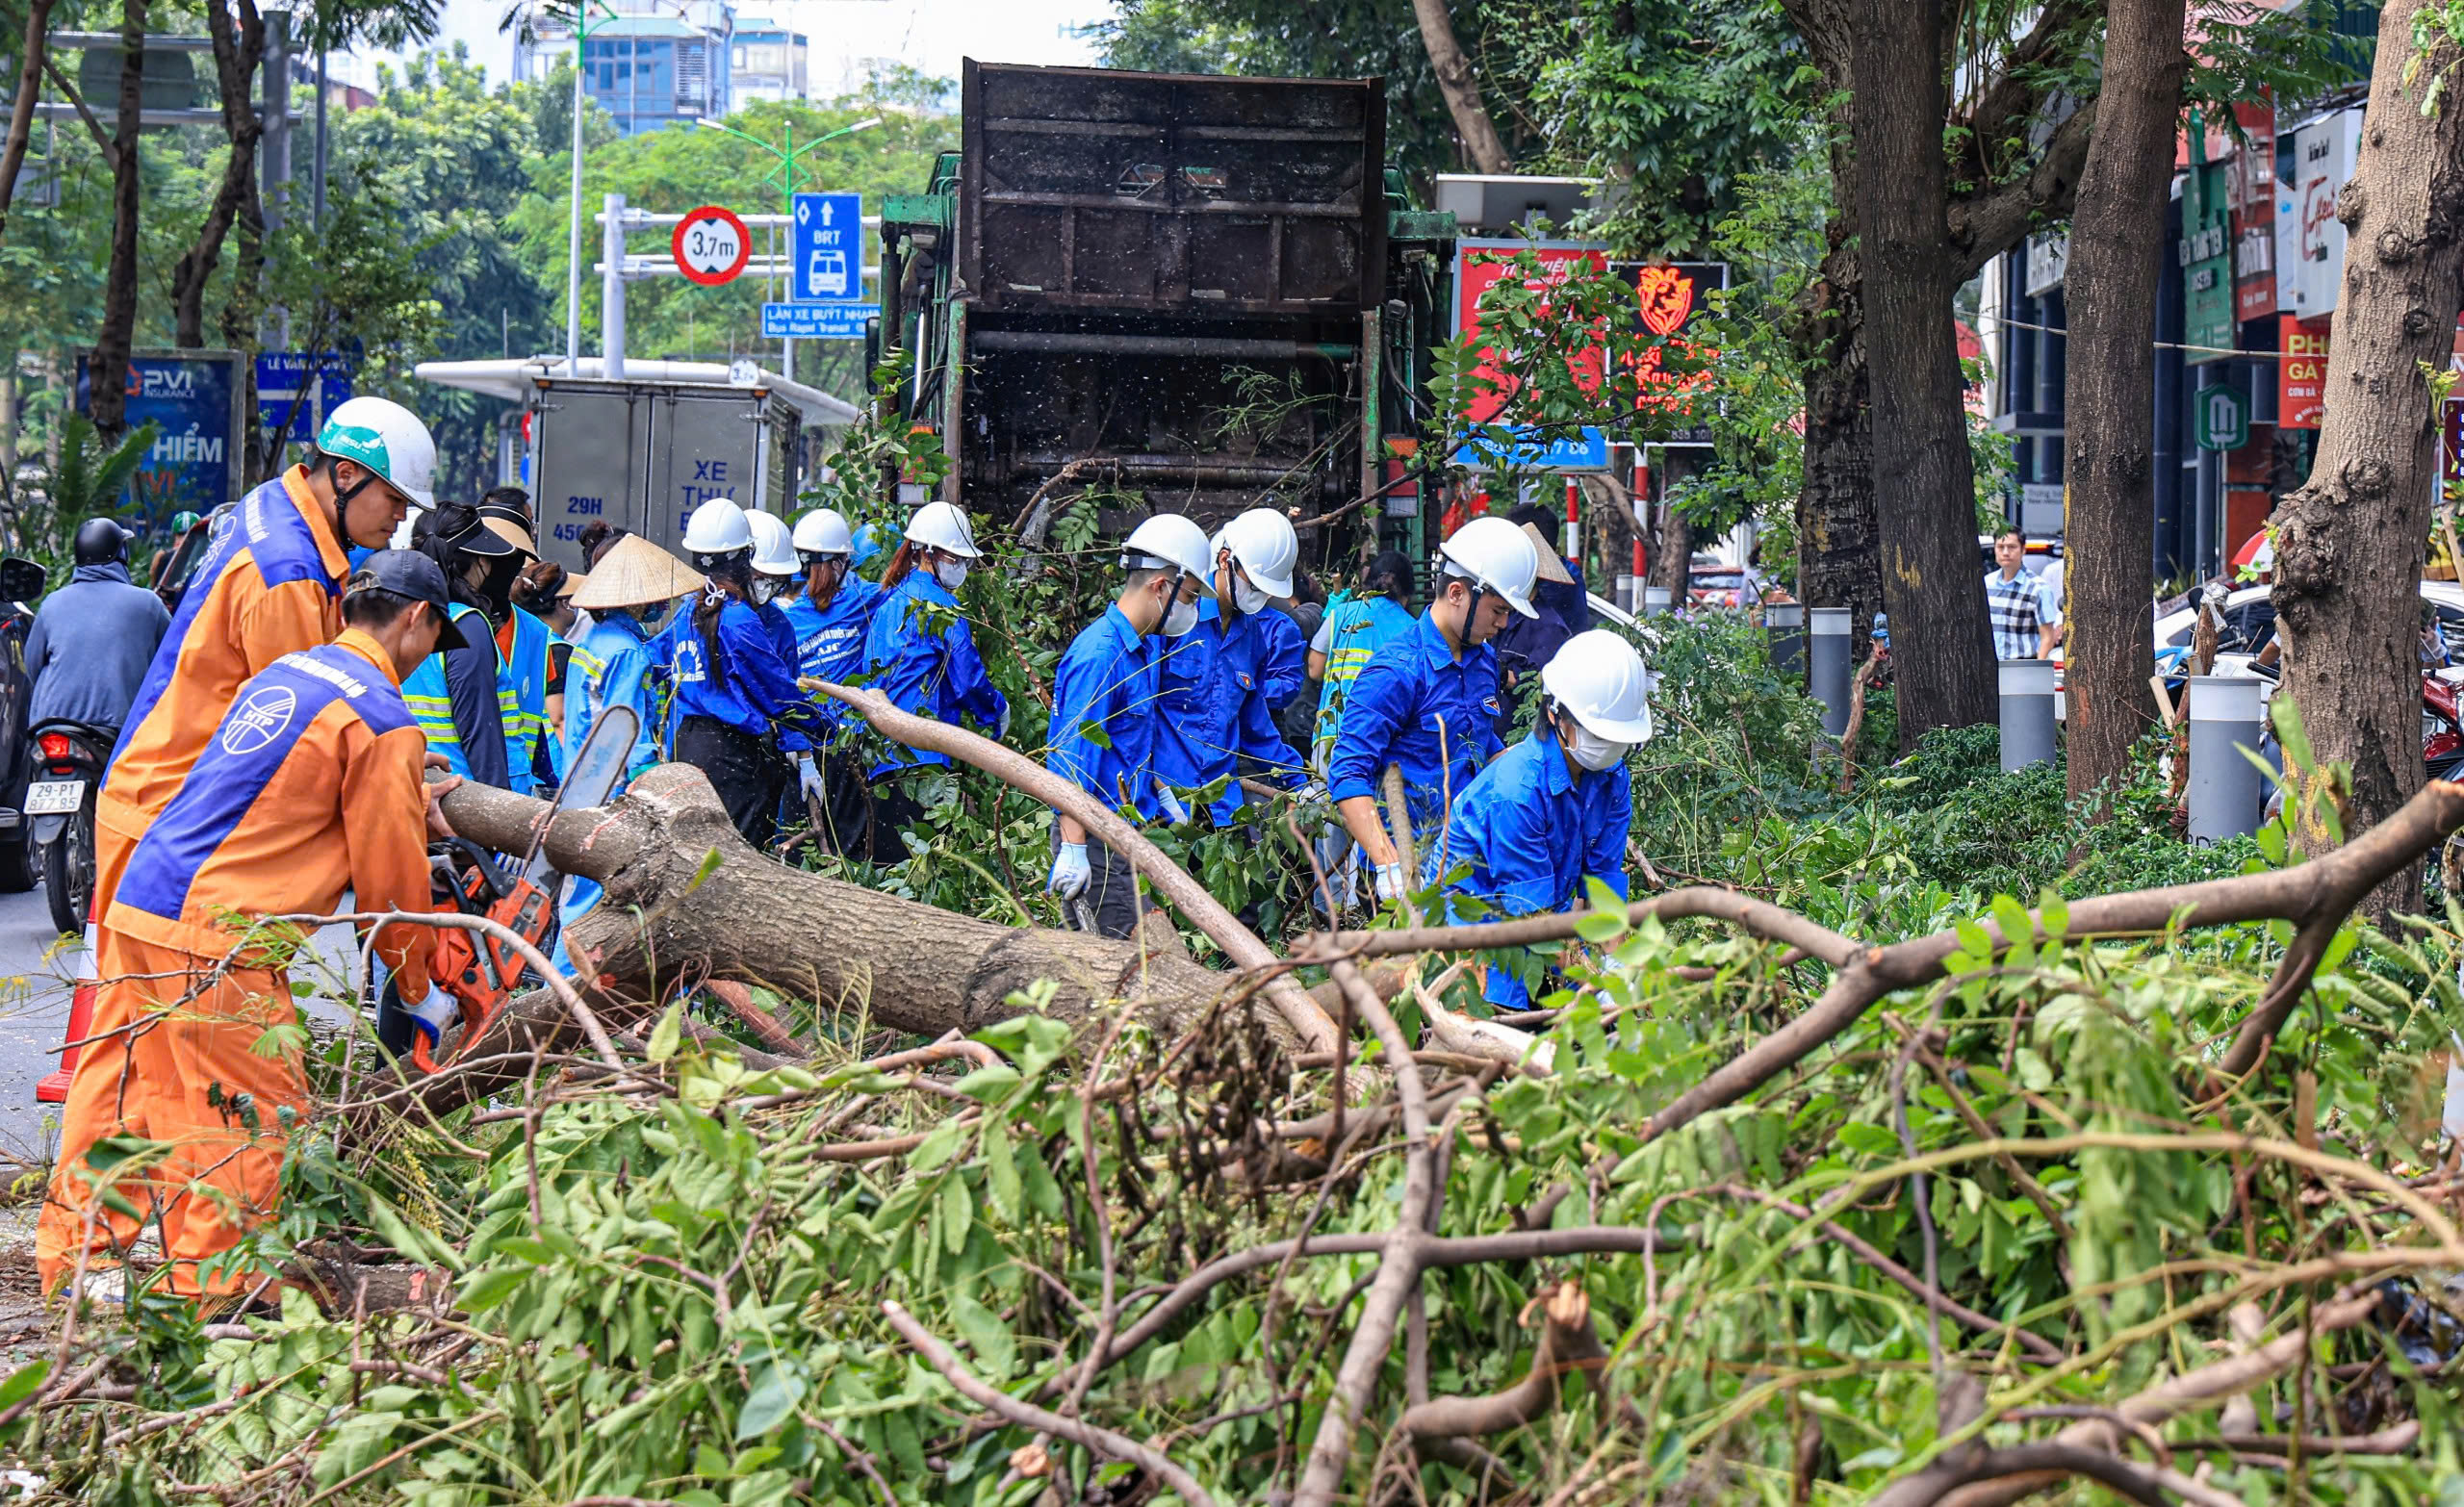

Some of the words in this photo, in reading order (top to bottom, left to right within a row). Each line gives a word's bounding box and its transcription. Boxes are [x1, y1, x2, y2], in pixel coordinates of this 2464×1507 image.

[813, 230, 840, 245] BRT
[794, 308, 809, 320] XE
[2288, 360, 2319, 380] GÀ
[144, 370, 192, 390] PVI
[144, 389, 195, 398] INSURANCE
[153, 421, 222, 463] HIỂM
[693, 460, 728, 481] XE
[567, 496, 603, 515] 29H
[243, 709, 275, 728] HTP
[37, 783, 75, 798] 29-P1
